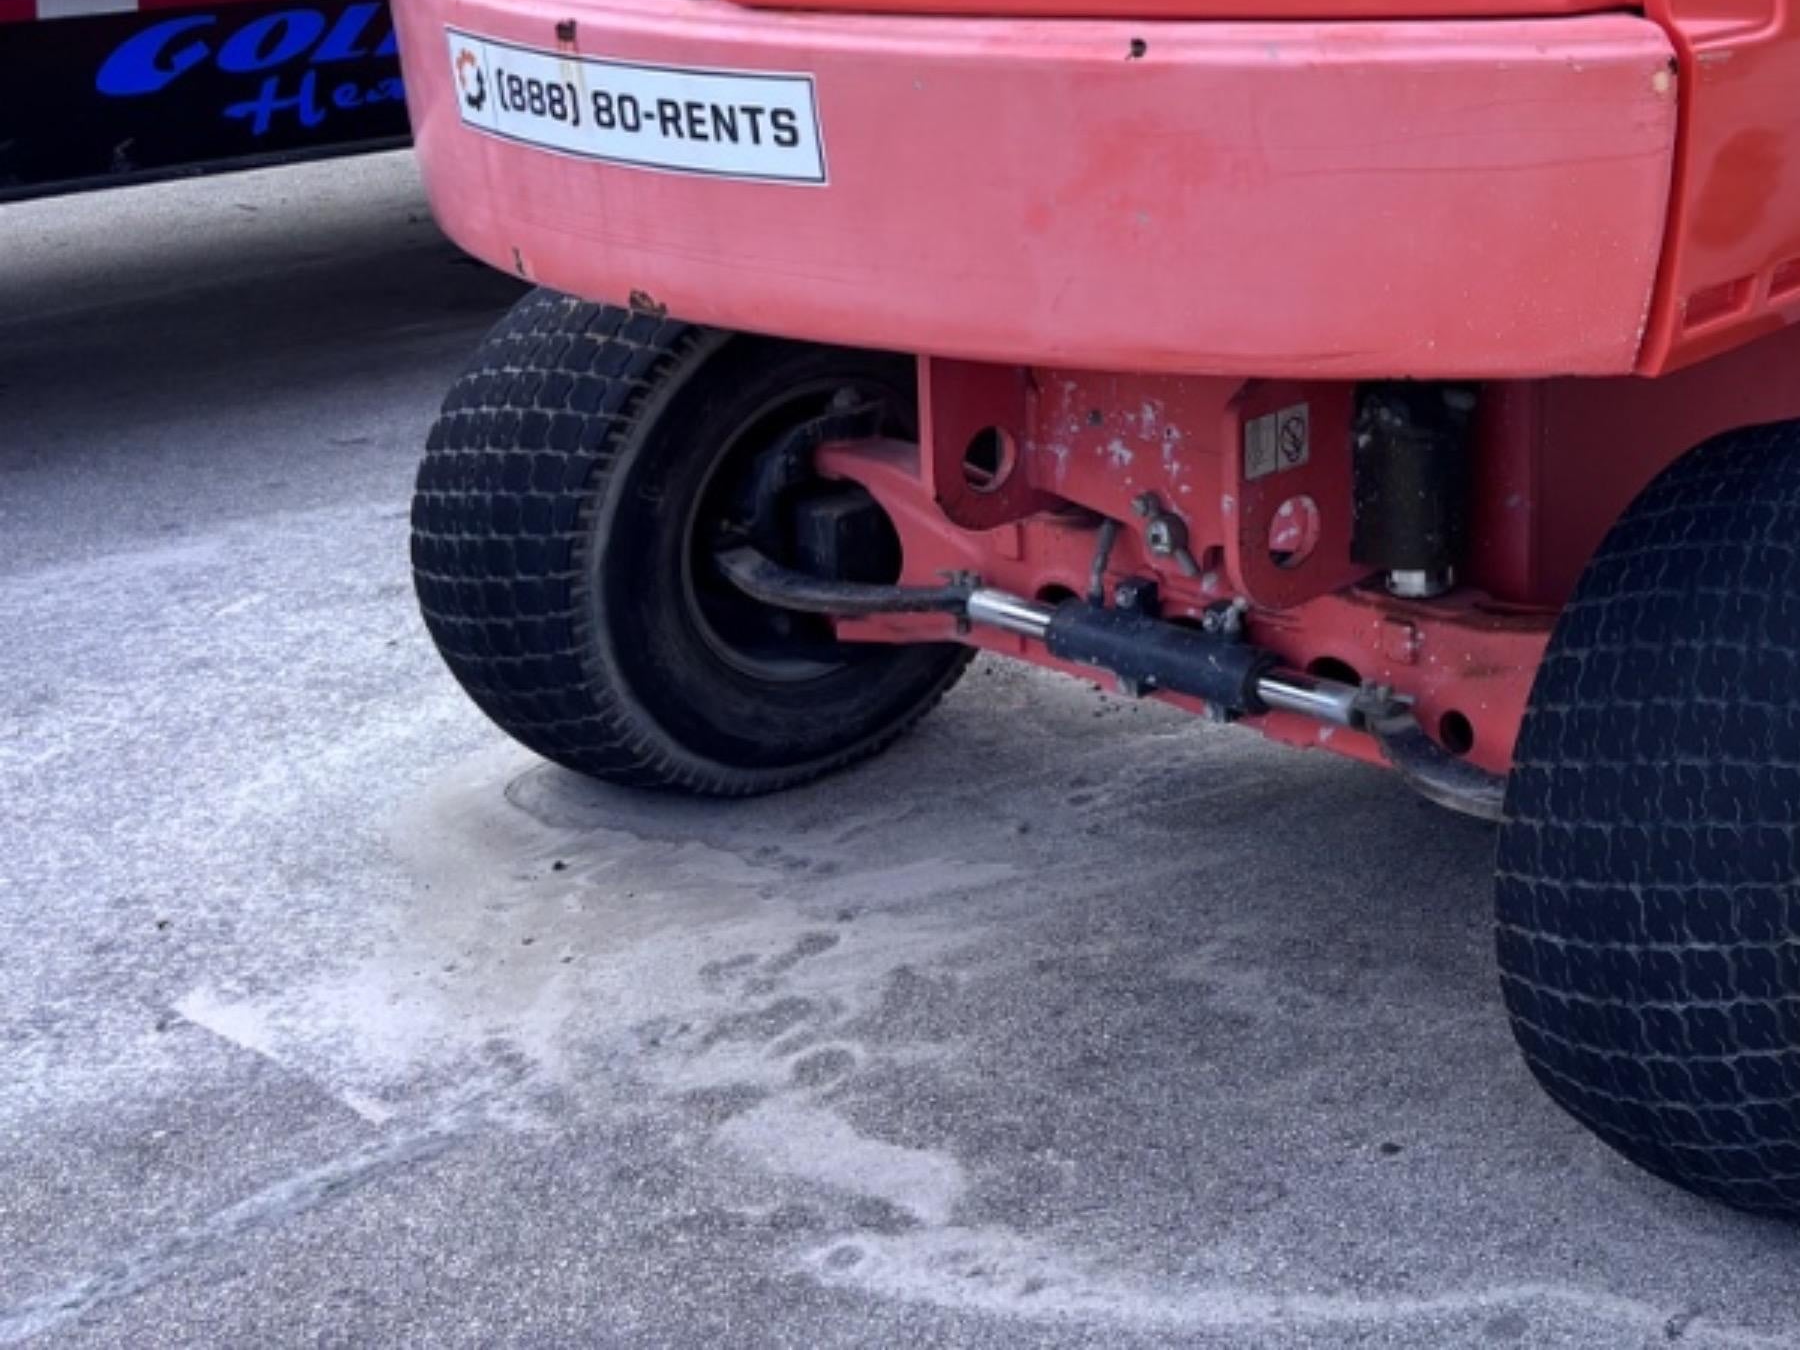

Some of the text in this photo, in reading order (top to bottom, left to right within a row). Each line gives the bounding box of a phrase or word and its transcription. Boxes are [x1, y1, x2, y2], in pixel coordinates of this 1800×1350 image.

[95, 3, 401, 96] GOL
[497, 68, 800, 148] (888) 80-RENTS
